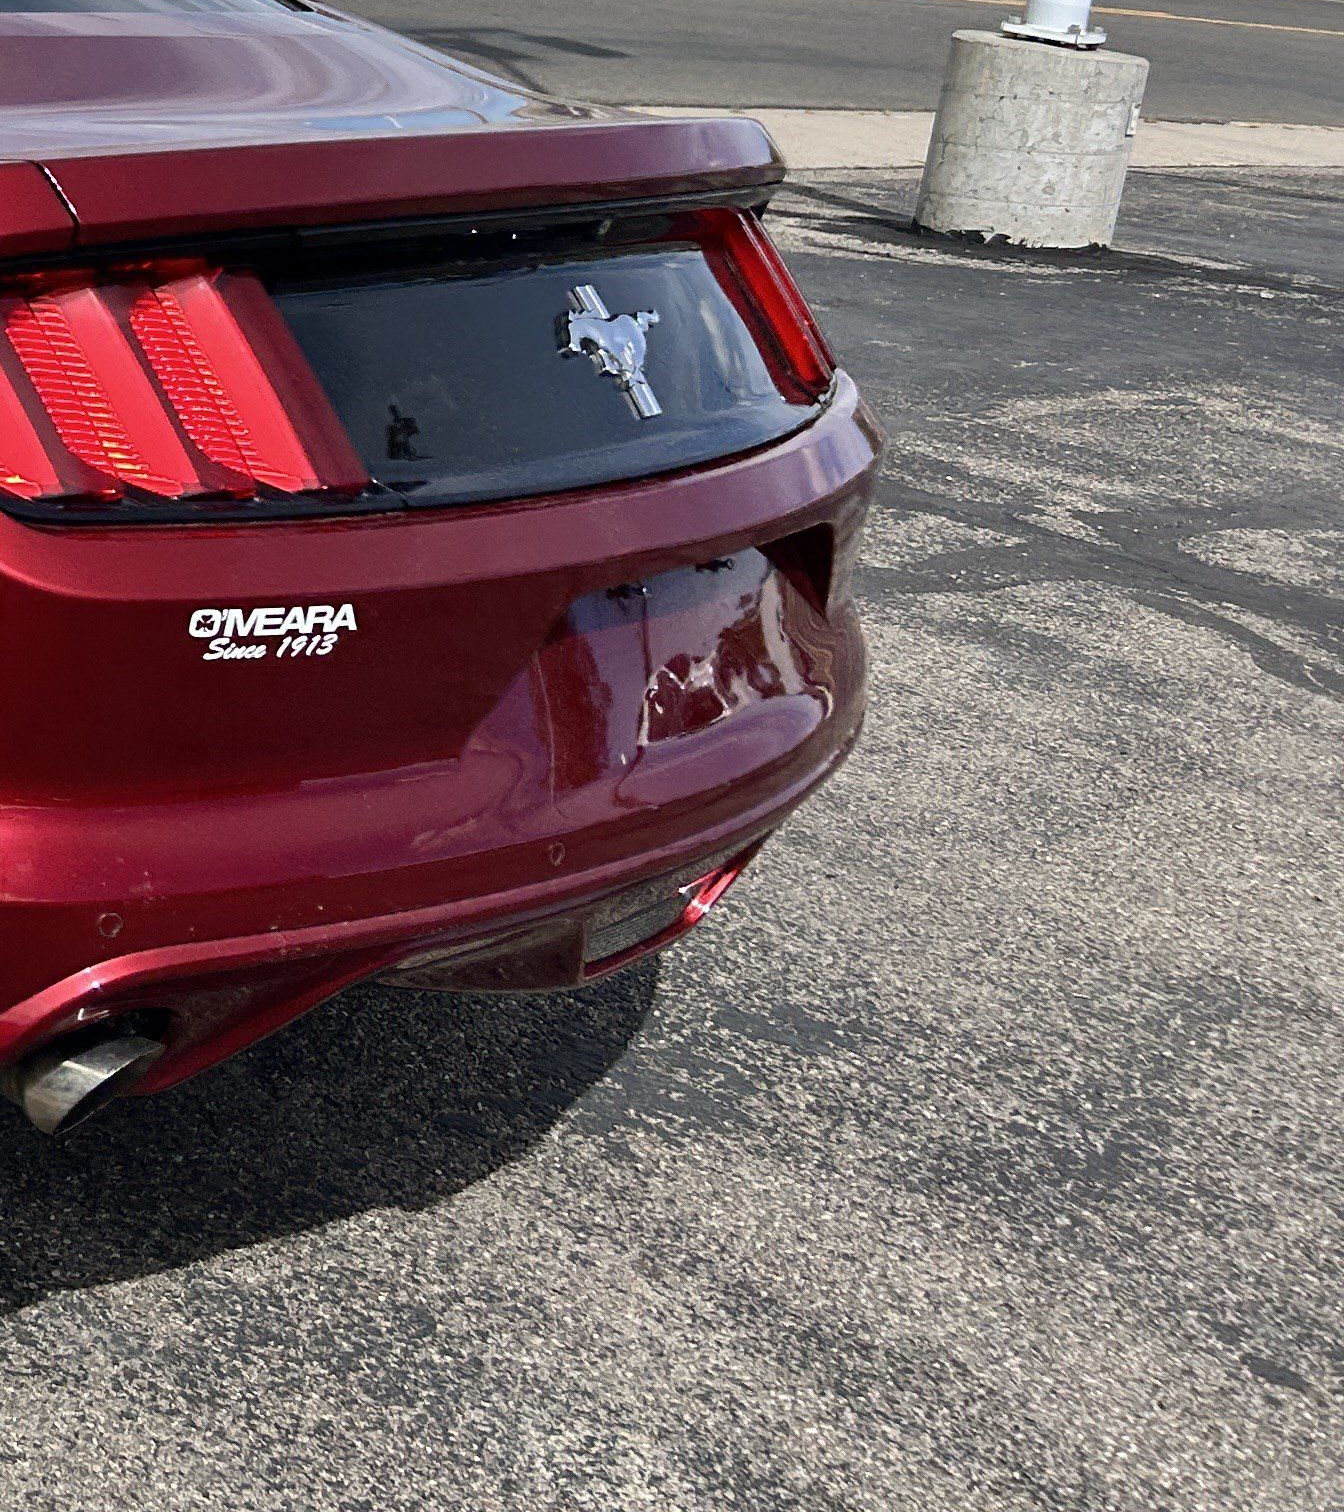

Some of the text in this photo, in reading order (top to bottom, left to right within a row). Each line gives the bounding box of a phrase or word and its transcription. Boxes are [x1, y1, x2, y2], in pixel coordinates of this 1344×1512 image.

[188, 603, 358, 638] O'MEARA
[202, 633, 338, 661] Since 1913
